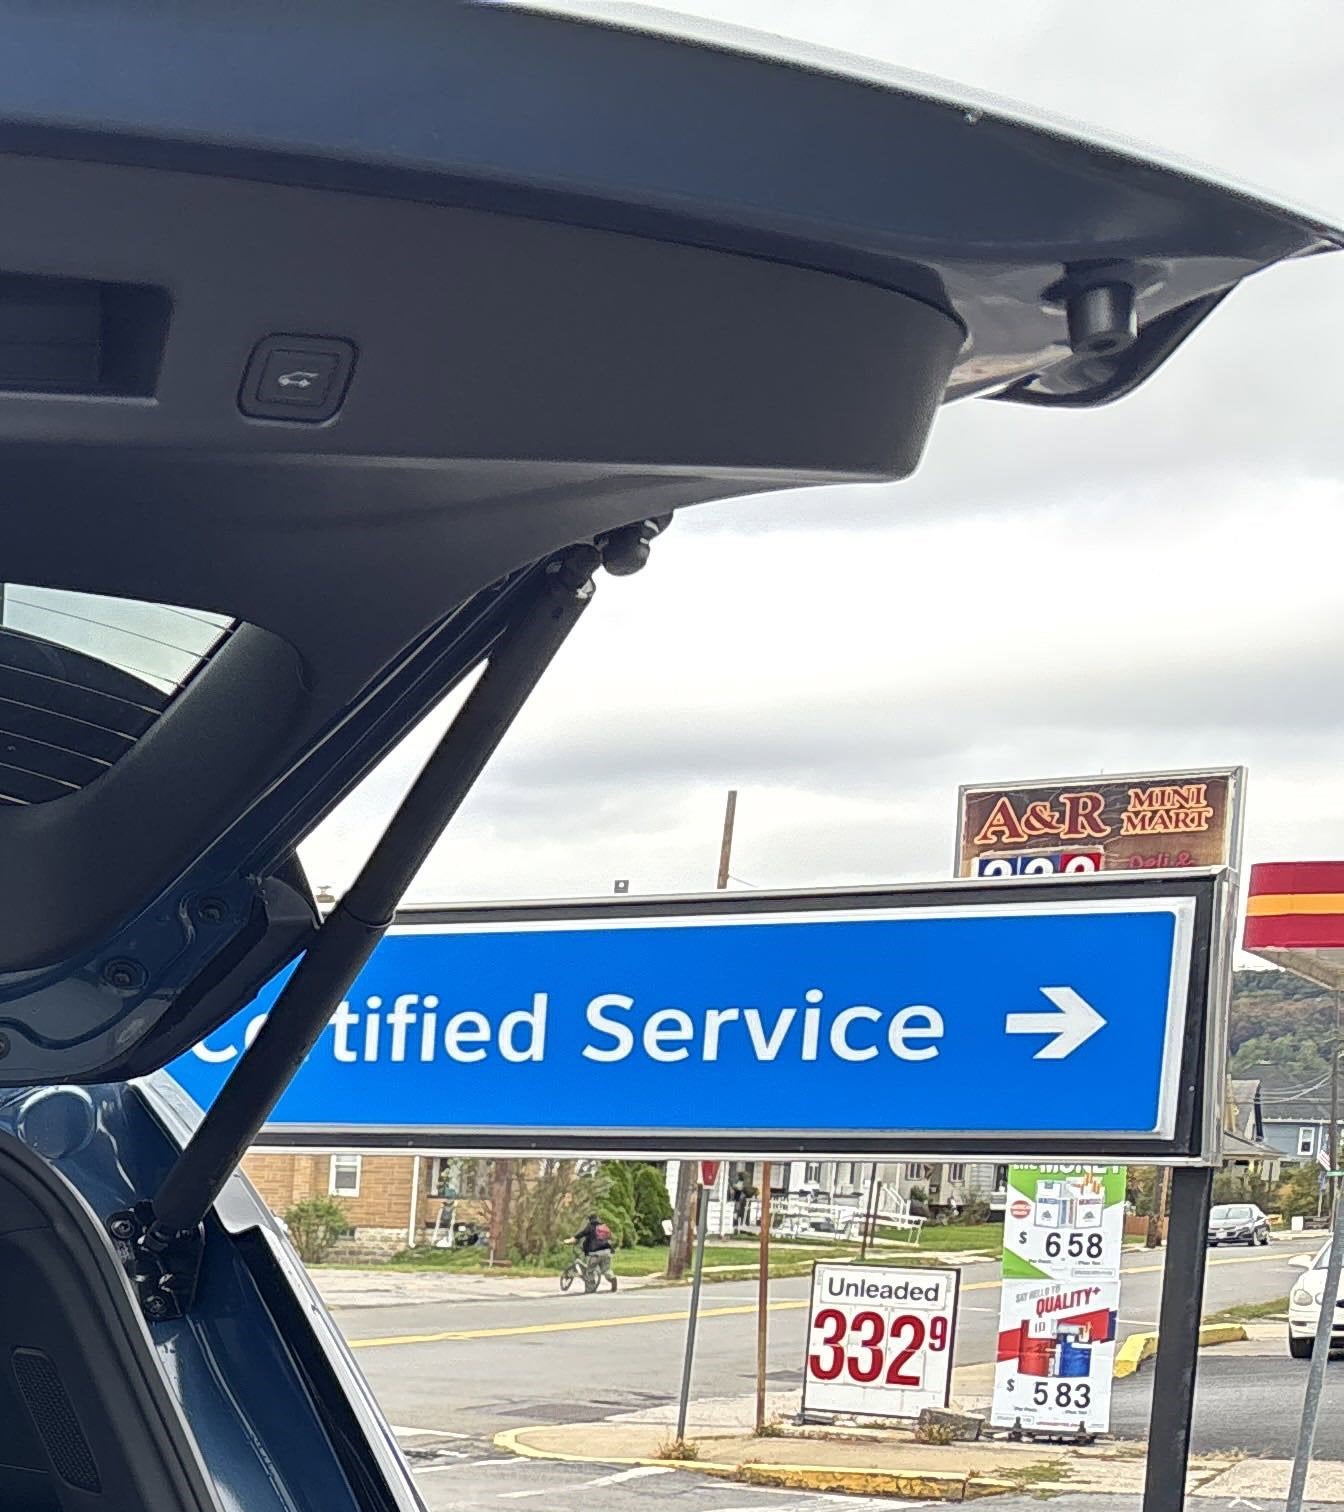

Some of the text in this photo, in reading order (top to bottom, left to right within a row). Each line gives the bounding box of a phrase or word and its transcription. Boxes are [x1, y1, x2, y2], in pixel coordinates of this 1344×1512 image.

[1128, 784, 1207, 811] MINI
[974, 792, 1111, 844] A&R
[1120, 807, 1213, 835] MART
[191, 989, 945, 1063] tified Service
[1018, 1230, 1028, 1245] $
[828, 1277, 940, 1302] Unleaded
